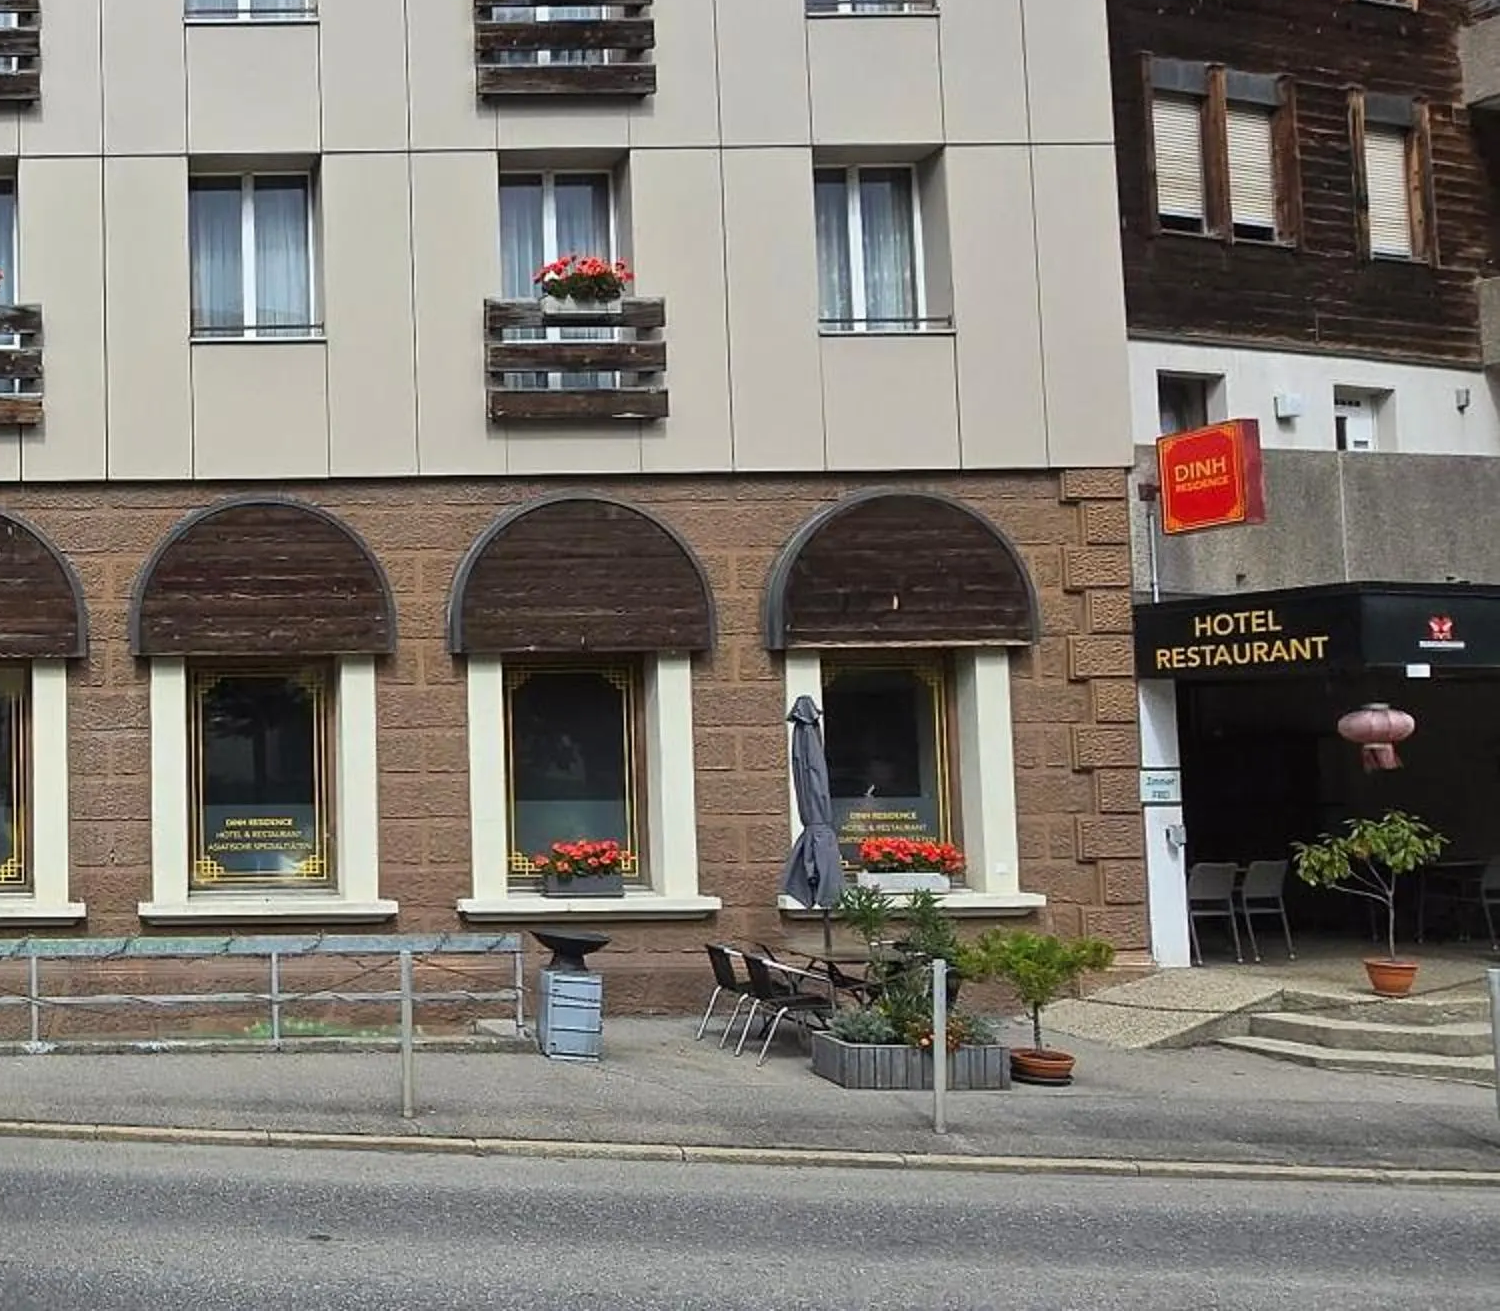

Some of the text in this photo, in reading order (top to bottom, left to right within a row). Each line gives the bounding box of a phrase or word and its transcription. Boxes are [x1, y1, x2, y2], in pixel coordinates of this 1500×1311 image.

[1174, 456, 1227, 482] DINH
[1175, 475, 1231, 493] RESIDENCE
[1195, 609, 1282, 637] HOTEL
[1156, 636, 1329, 670] RESTAURANT
[225, 818, 293, 826] DINH RESIDENCE
[849, 811, 917, 820] DINH RESIDENCE
[215, 830, 242, 838] HOTEL
[252, 830, 302, 838] RESTAURANT
